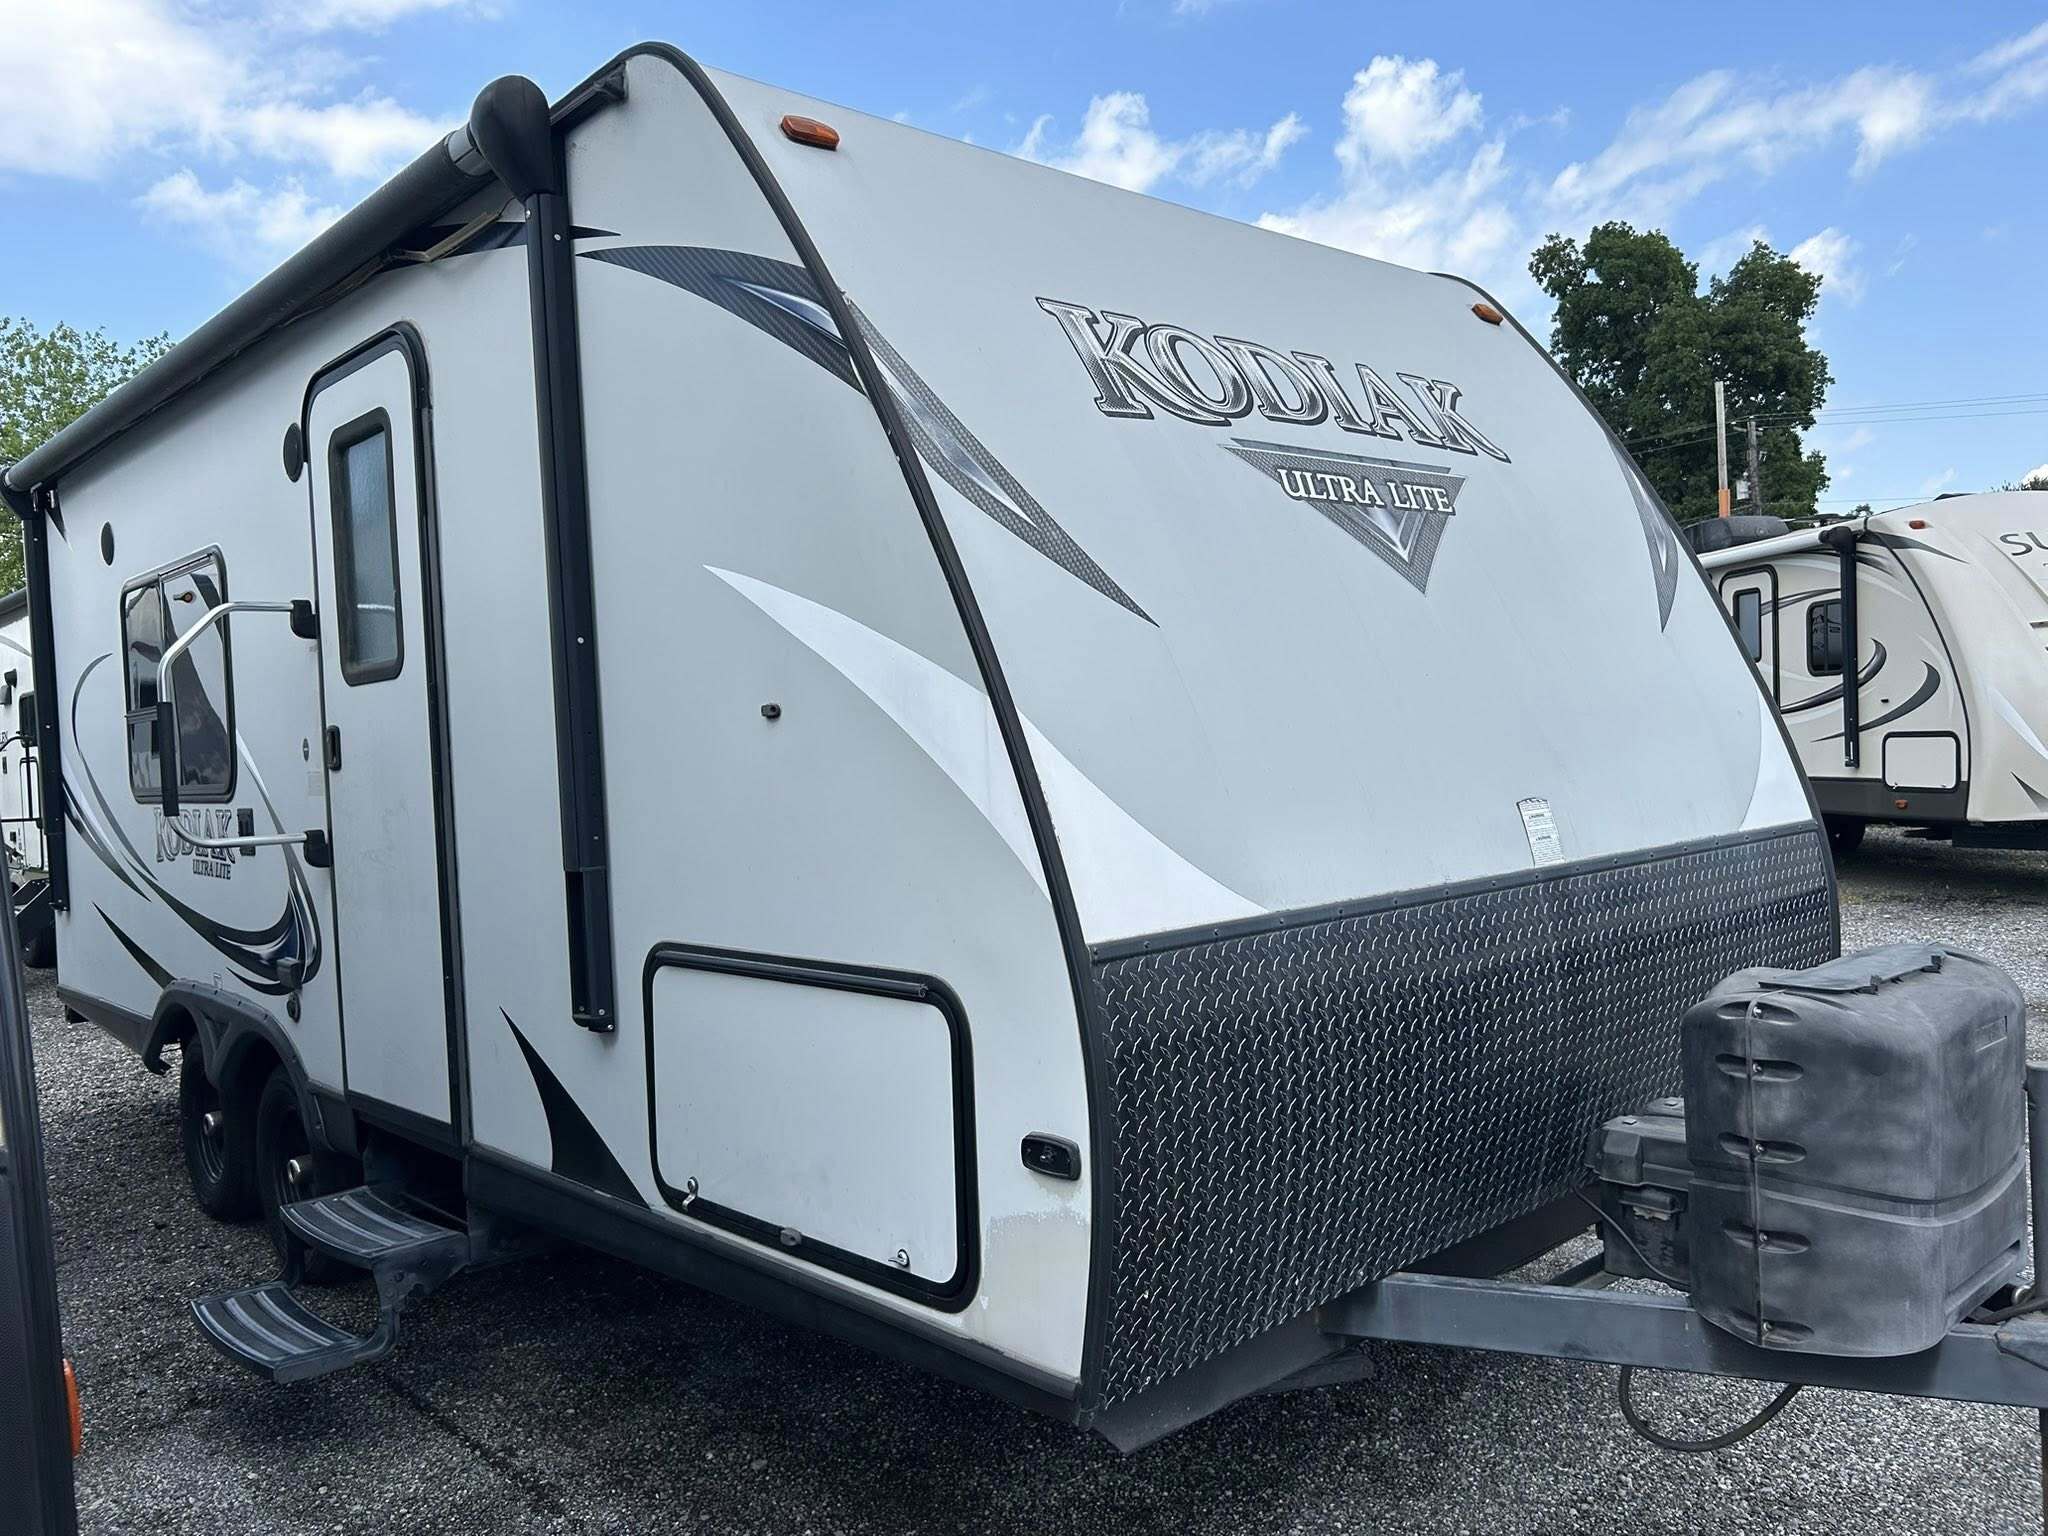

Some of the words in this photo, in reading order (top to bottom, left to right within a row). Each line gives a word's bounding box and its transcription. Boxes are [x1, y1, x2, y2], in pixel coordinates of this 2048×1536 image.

[1035, 297, 1511, 463] KODIAK
[1276, 467, 1385, 507] ULTRA
[1386, 481, 1456, 515] LITE
[192, 859, 214, 877] ULTRA
[215, 862, 231, 880] LITE
